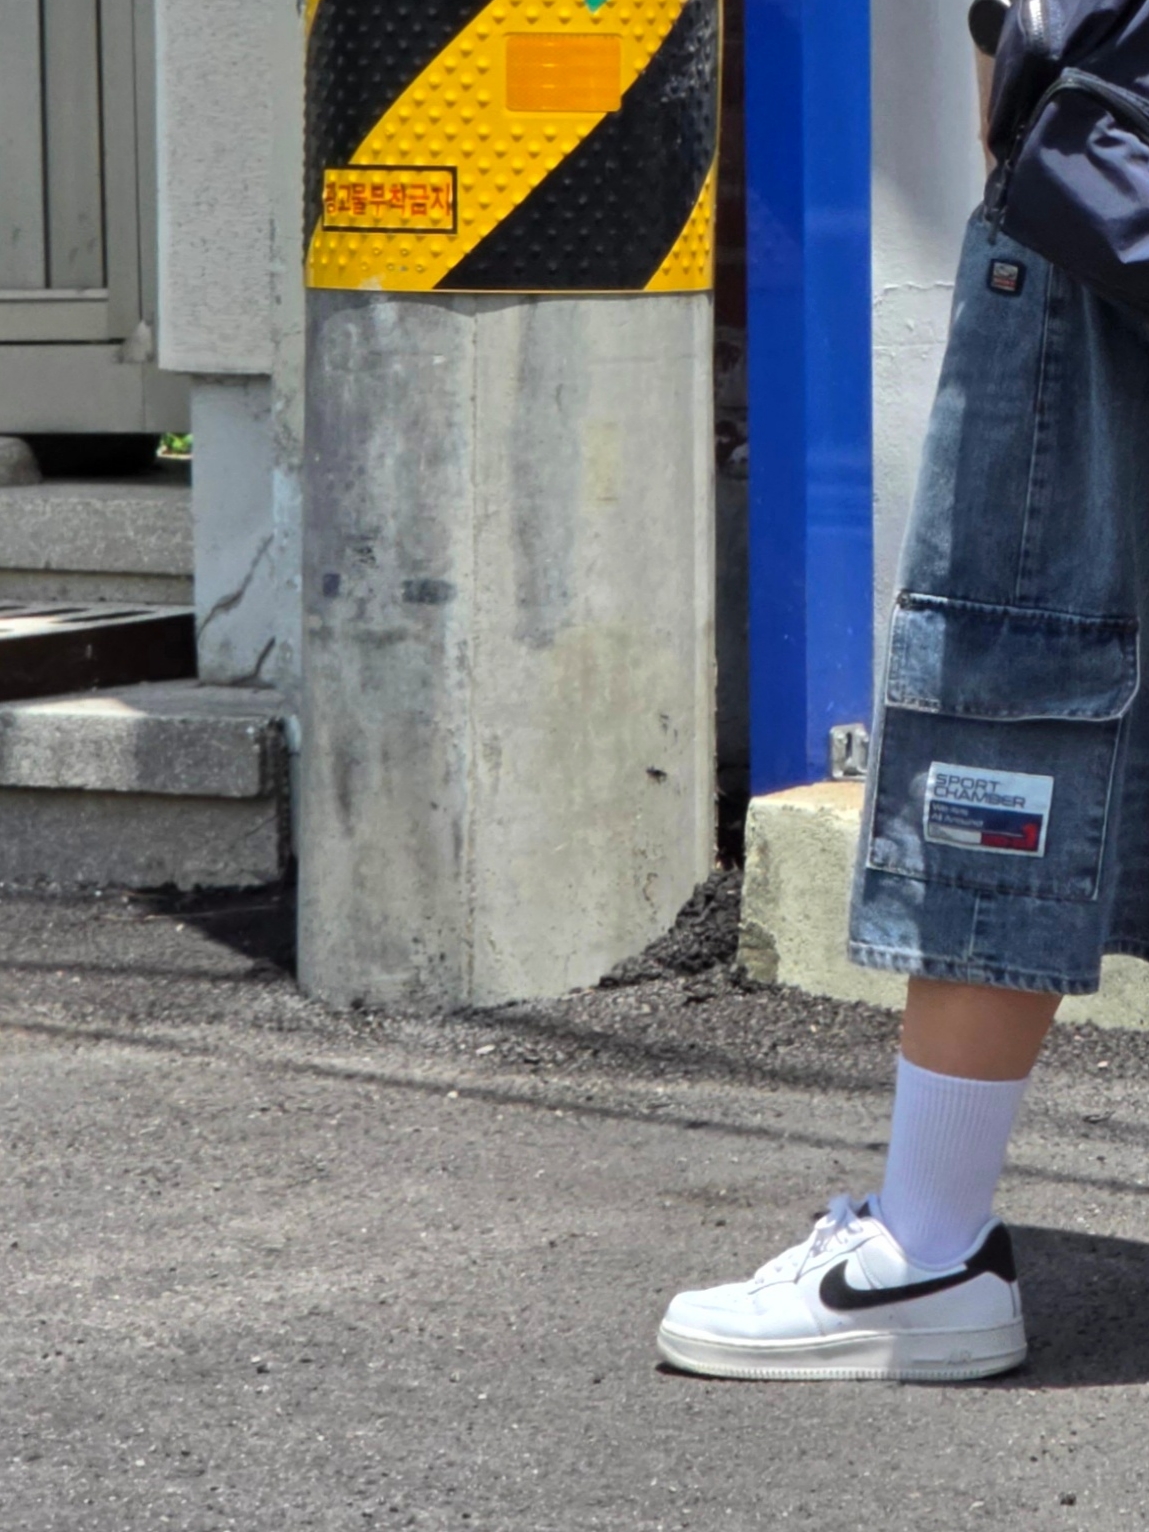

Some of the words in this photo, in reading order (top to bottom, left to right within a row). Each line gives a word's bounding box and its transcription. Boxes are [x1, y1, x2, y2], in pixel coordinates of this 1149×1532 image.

[325, 182, 450, 217] 광고물부착금지
[935, 773, 1000, 793] SPORT
[933, 786, 1026, 809] CHAMBER
